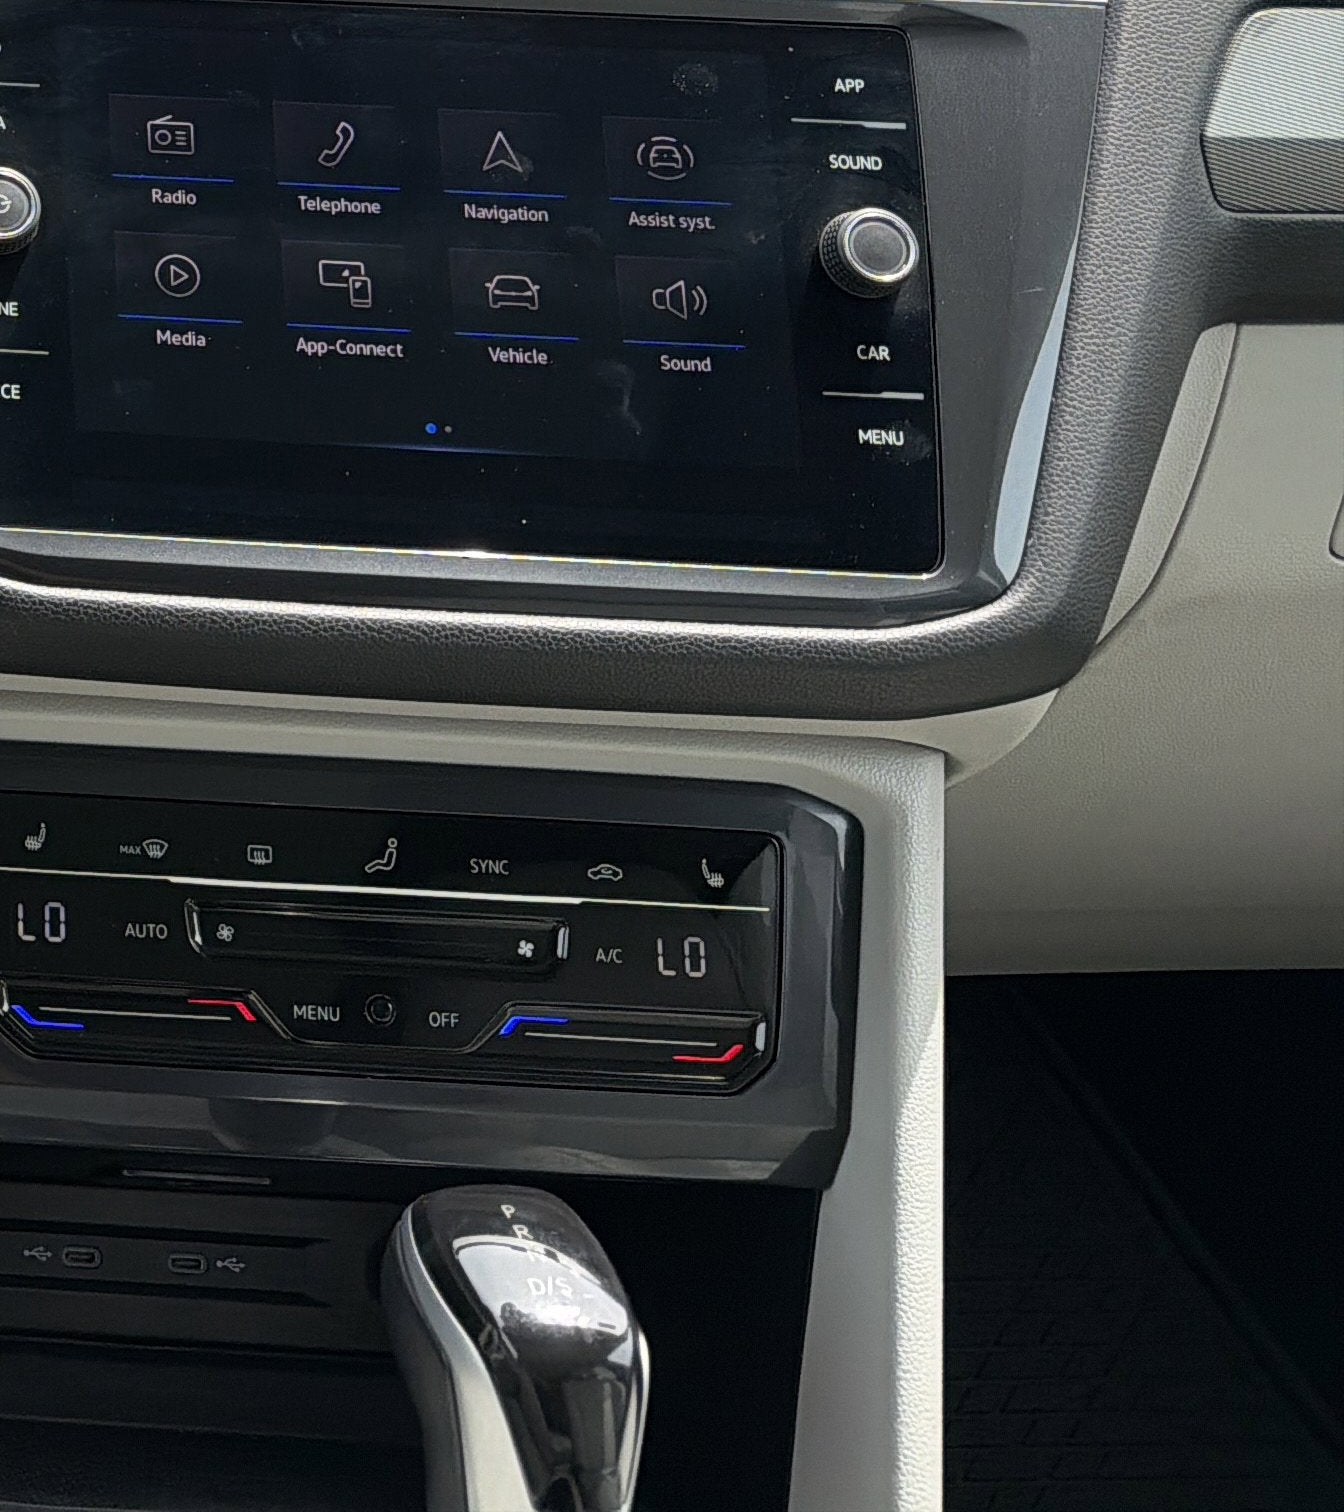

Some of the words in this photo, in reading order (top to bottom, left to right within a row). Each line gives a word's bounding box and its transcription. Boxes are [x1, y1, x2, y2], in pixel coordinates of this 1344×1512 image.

[834, 77, 865, 93] APP
[828, 153, 883, 171] SOUND
[151, 188, 197, 205] Radio
[297, 195, 381, 216] Telephone
[463, 203, 549, 224] Navigation
[628, 210, 676, 228] Assist
[678, 215, 716, 233] syst.
[156, 329, 206, 347] Media
[295, 336, 404, 358] App-Connect
[487, 346, 548, 365] Vehicle
[856, 344, 891, 362] CAR
[660, 354, 712, 372] Sound
[858, 428, 905, 446] MENU
[119, 844, 142, 855] MAX
[469, 857, 510, 876] SYNC
[17, 901, 66, 943] LO
[124, 922, 168, 940] AUTO
[595, 947, 623, 964] A/C
[657, 936, 707, 978] LO
[293, 1004, 340, 1022] MENU
[428, 1011, 460, 1028] OFF
[500, 1204, 517, 1220] P
[511, 1223, 535, 1240] R
